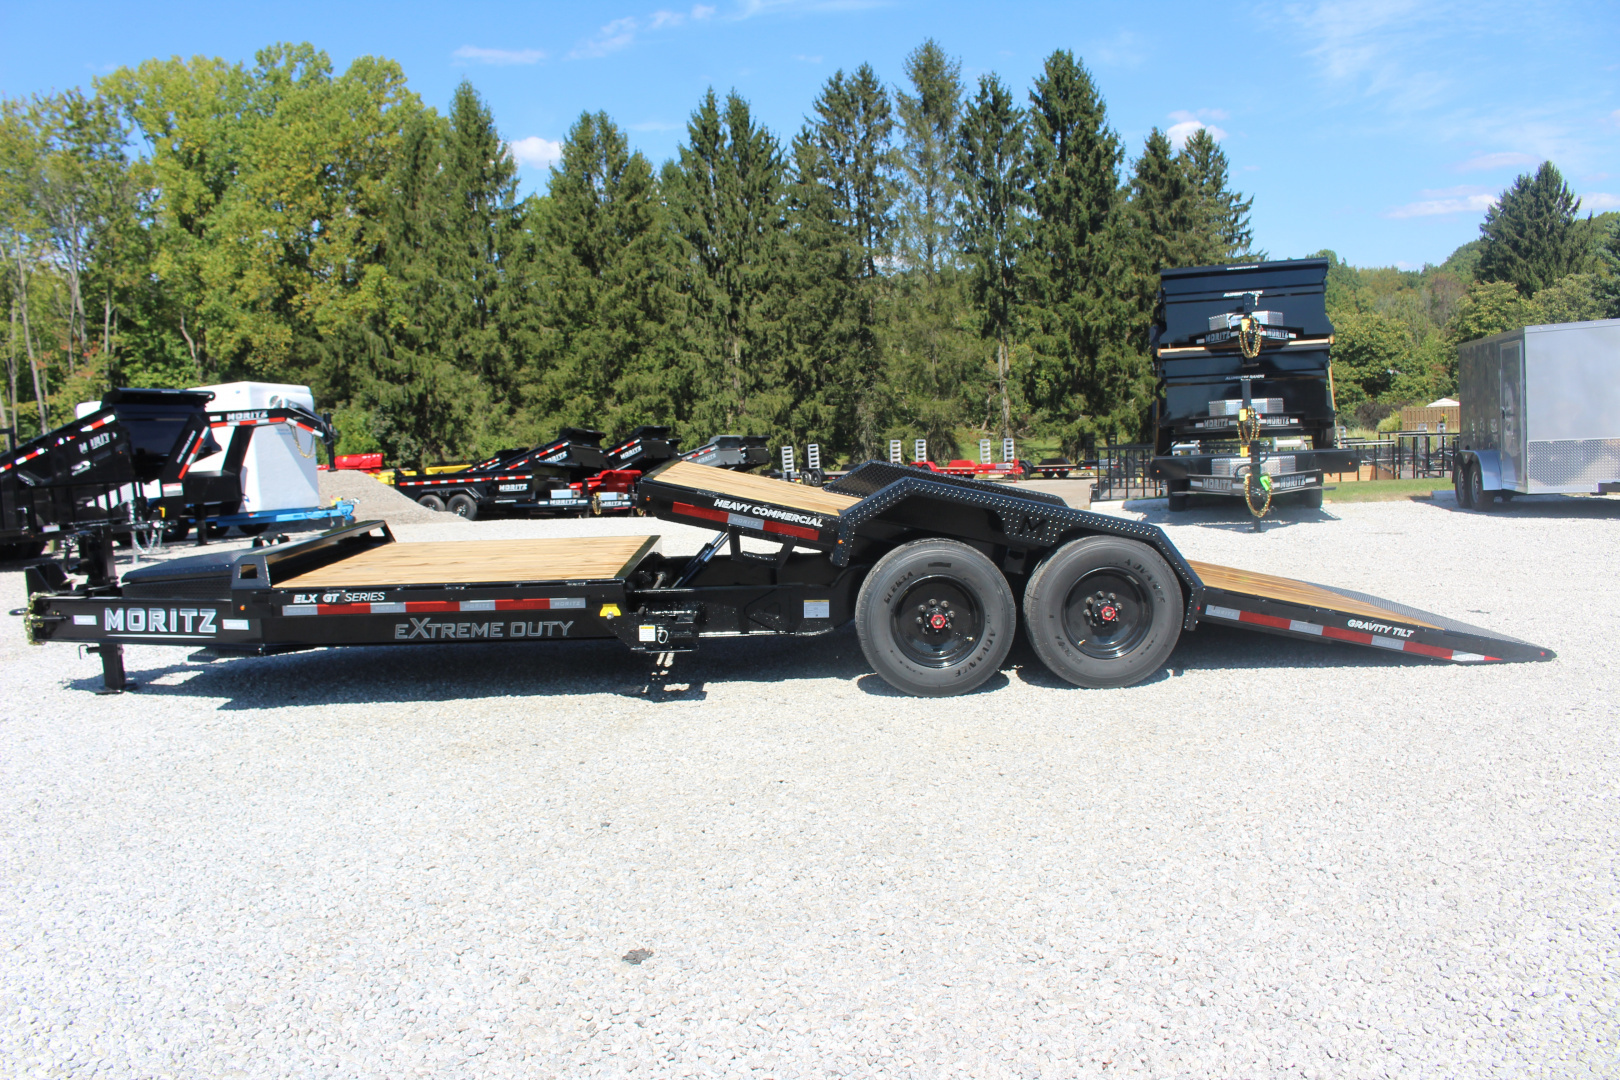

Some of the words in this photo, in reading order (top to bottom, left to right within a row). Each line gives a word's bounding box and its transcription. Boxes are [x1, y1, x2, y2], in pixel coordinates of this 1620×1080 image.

[1205, 331, 1231, 343] MORITZ
[1266, 328, 1289, 339] MORITZ
[226, 410, 268, 420] MORITZ
[1266, 416, 1289, 425] MORITZ
[1204, 419, 1229, 428] MORITZ
[620, 445, 642, 460] MORITZ
[1202, 479, 1232, 490] MORITZ
[1280, 475, 1306, 487] MORITZ
[499, 484, 528, 492] MORITZ
[714, 499, 751, 513] HEAVY
[752, 506, 823, 527] COMMERCIAL
[733, 517, 759, 527] MORITZ
[293, 594, 318, 604] ELX
[322, 593, 340, 603] GT
[344, 592, 385, 602] SERIES
[104, 607, 217, 633] MORITZ
[395, 617, 504, 640] EXTREME
[510, 620, 574, 637] DUTY
[1347, 619, 1392, 634] GRAVITY
[1392, 627, 1415, 638] TILT
